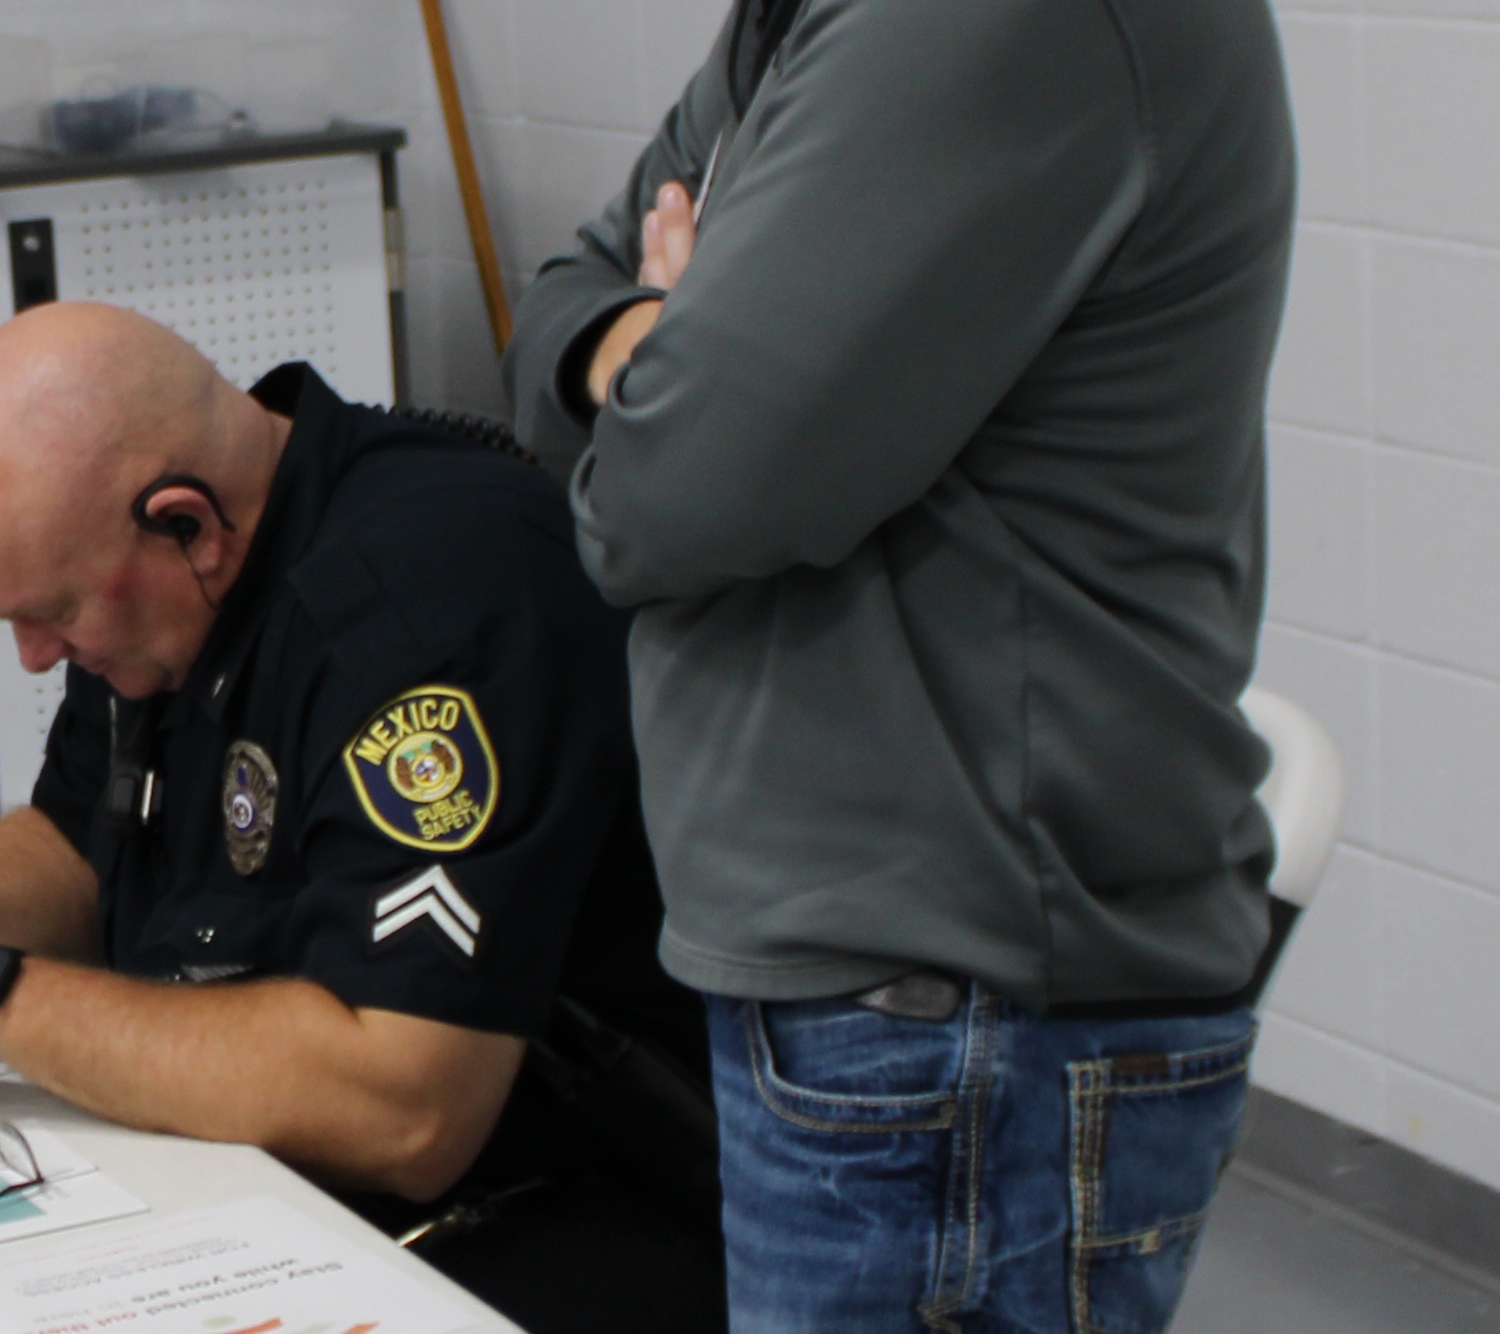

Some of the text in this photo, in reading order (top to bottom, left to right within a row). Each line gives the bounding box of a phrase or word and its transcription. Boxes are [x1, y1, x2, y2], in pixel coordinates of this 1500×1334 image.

[355, 699, 460, 765] MEXICO
[413, 789, 473, 825] PUBLIC
[421, 804, 482, 841] SAFETY
[145, 1275, 279, 1316] connected
